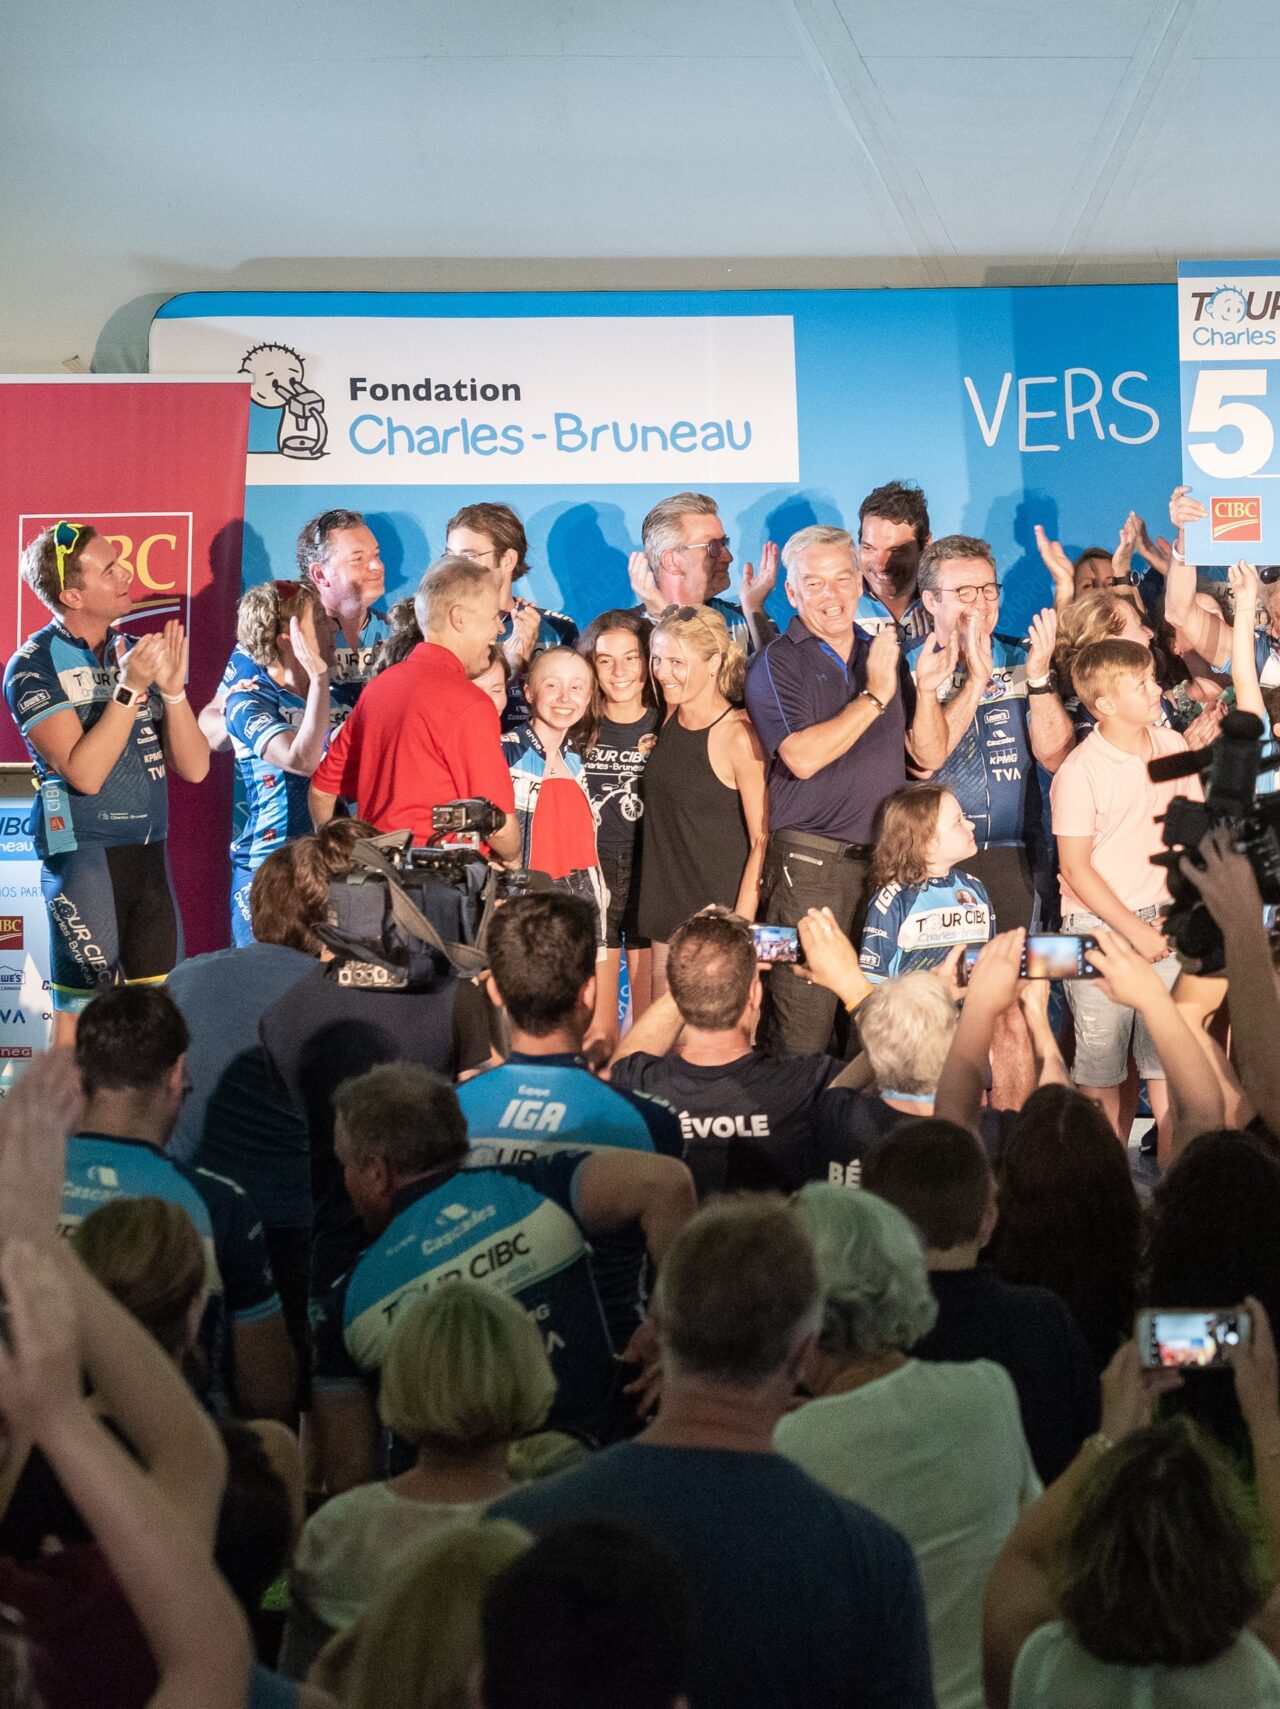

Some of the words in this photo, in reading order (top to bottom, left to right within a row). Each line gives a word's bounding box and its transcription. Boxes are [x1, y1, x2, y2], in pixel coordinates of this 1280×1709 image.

[348, 376, 522, 403] Fondation
[963, 366, 1161, 452] VERS
[1187, 369, 1274, 478] 5
[1214, 501, 1258, 520] CIBC
[104, 533, 177, 591] BC
[989, 753, 1018, 765] KPMG
[991, 767, 1022, 782] TVA
[0, 919, 22, 932] IBC
[0, 1009, 26, 1024] VA
[498, 1099, 567, 1132] IGA
[679, 1110, 771, 1139] ÉVOLE
[469, 1231, 531, 1280] CIBC
